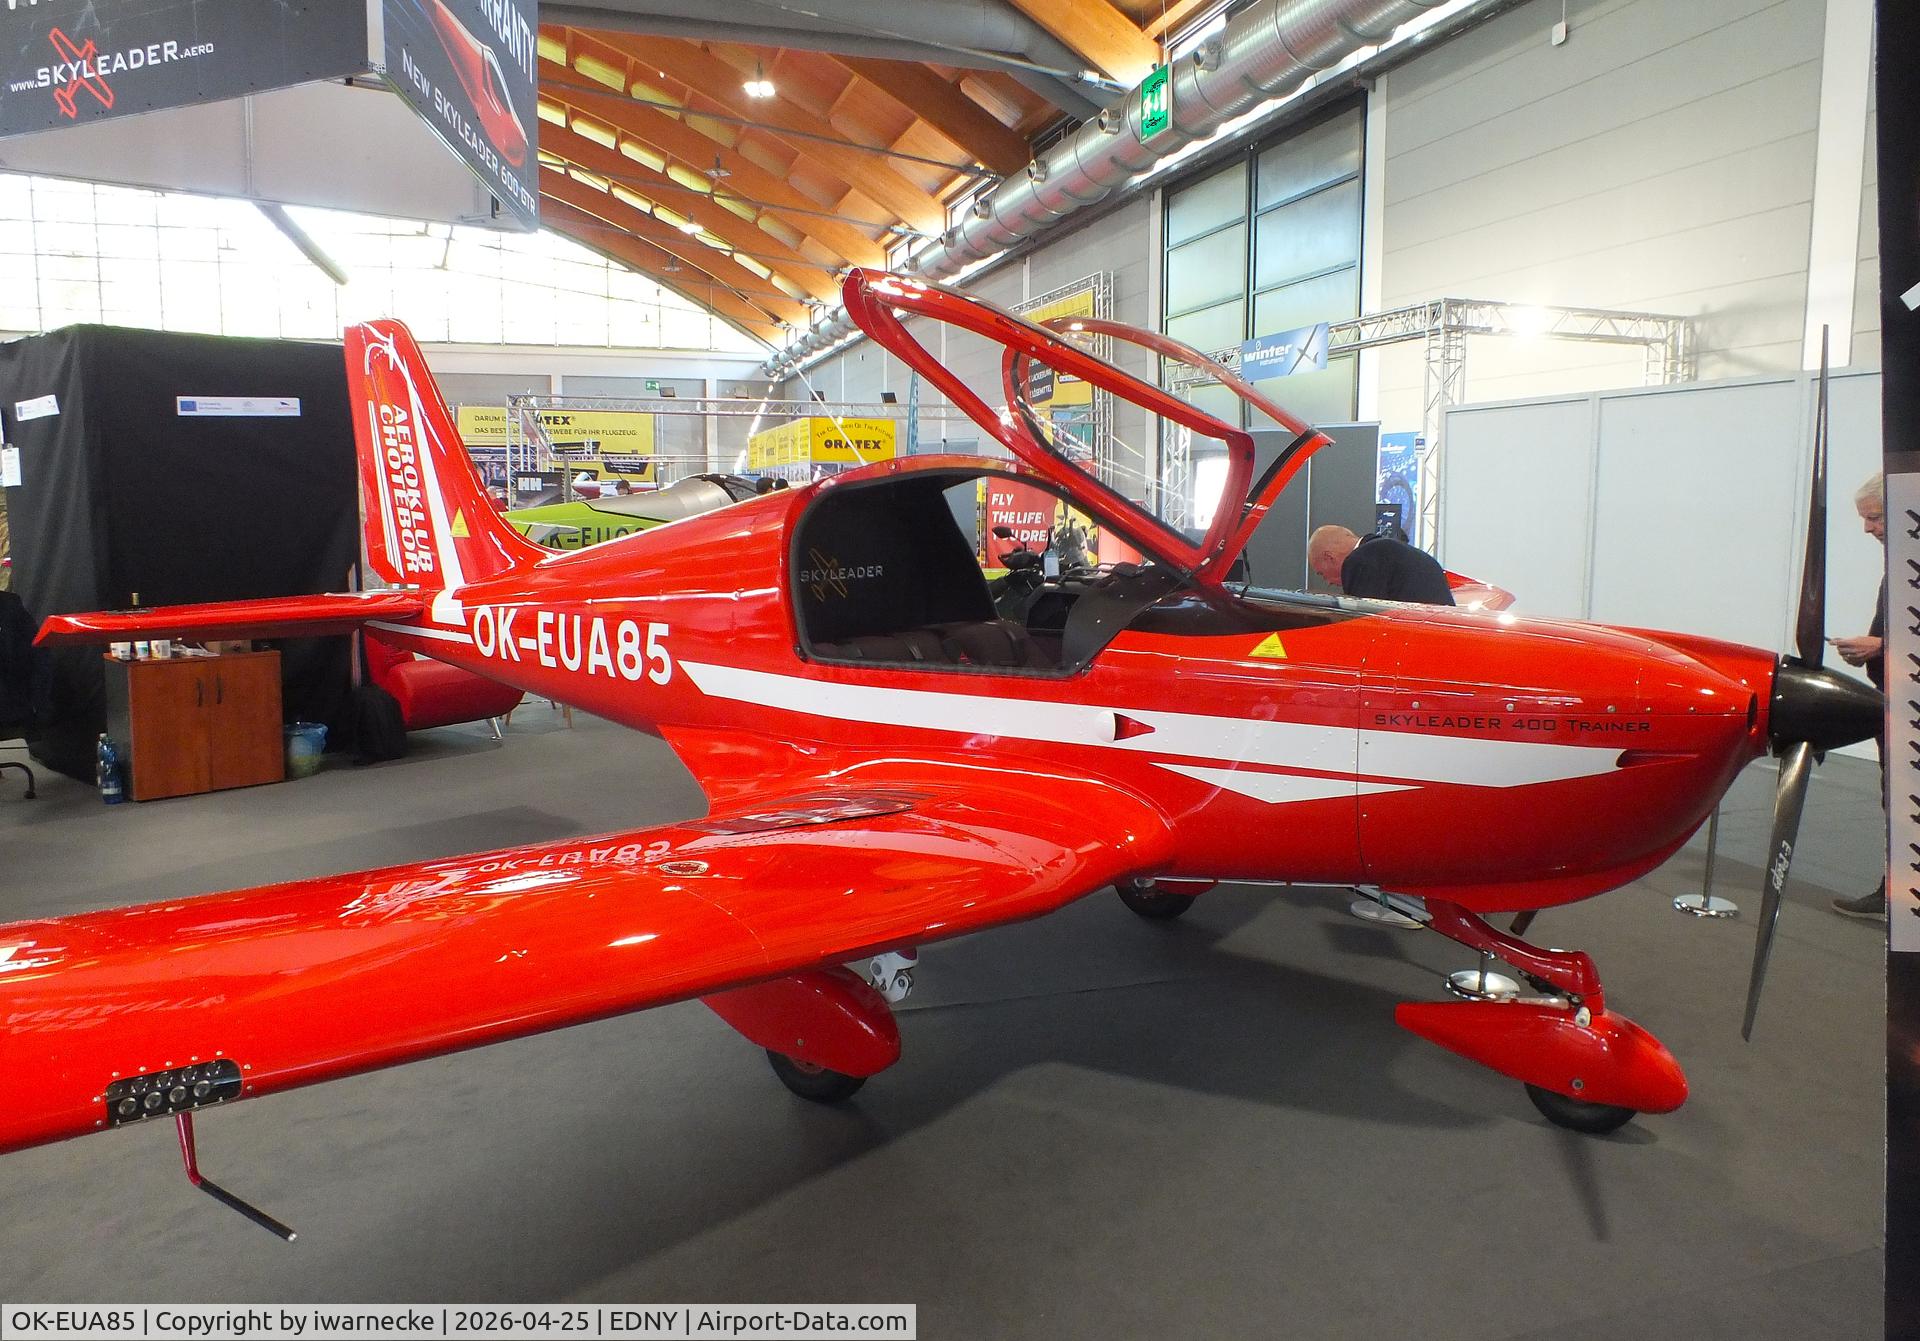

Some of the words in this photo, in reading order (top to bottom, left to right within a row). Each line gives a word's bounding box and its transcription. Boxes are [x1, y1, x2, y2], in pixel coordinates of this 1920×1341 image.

[402, 48, 431, 98] NEW
[434, 88, 499, 176] SKYLEADER
[501, 165, 520, 198] 600
[1244, 343, 1293, 363] winter
[392, 404, 434, 573] AEROKLUB
[991, 493, 1014, 506] FLY
[991, 511, 1016, 524] THE
[1016, 511, 1043, 525] LIFE
[1020, 529, 1049, 542] DRE
[800, 565, 884, 582] SKYLEADER
[474, 605, 672, 685] OK-EUA85
[1374, 713, 1500, 730] SKYLEADER
[1511, 717, 1556, 731] 400
